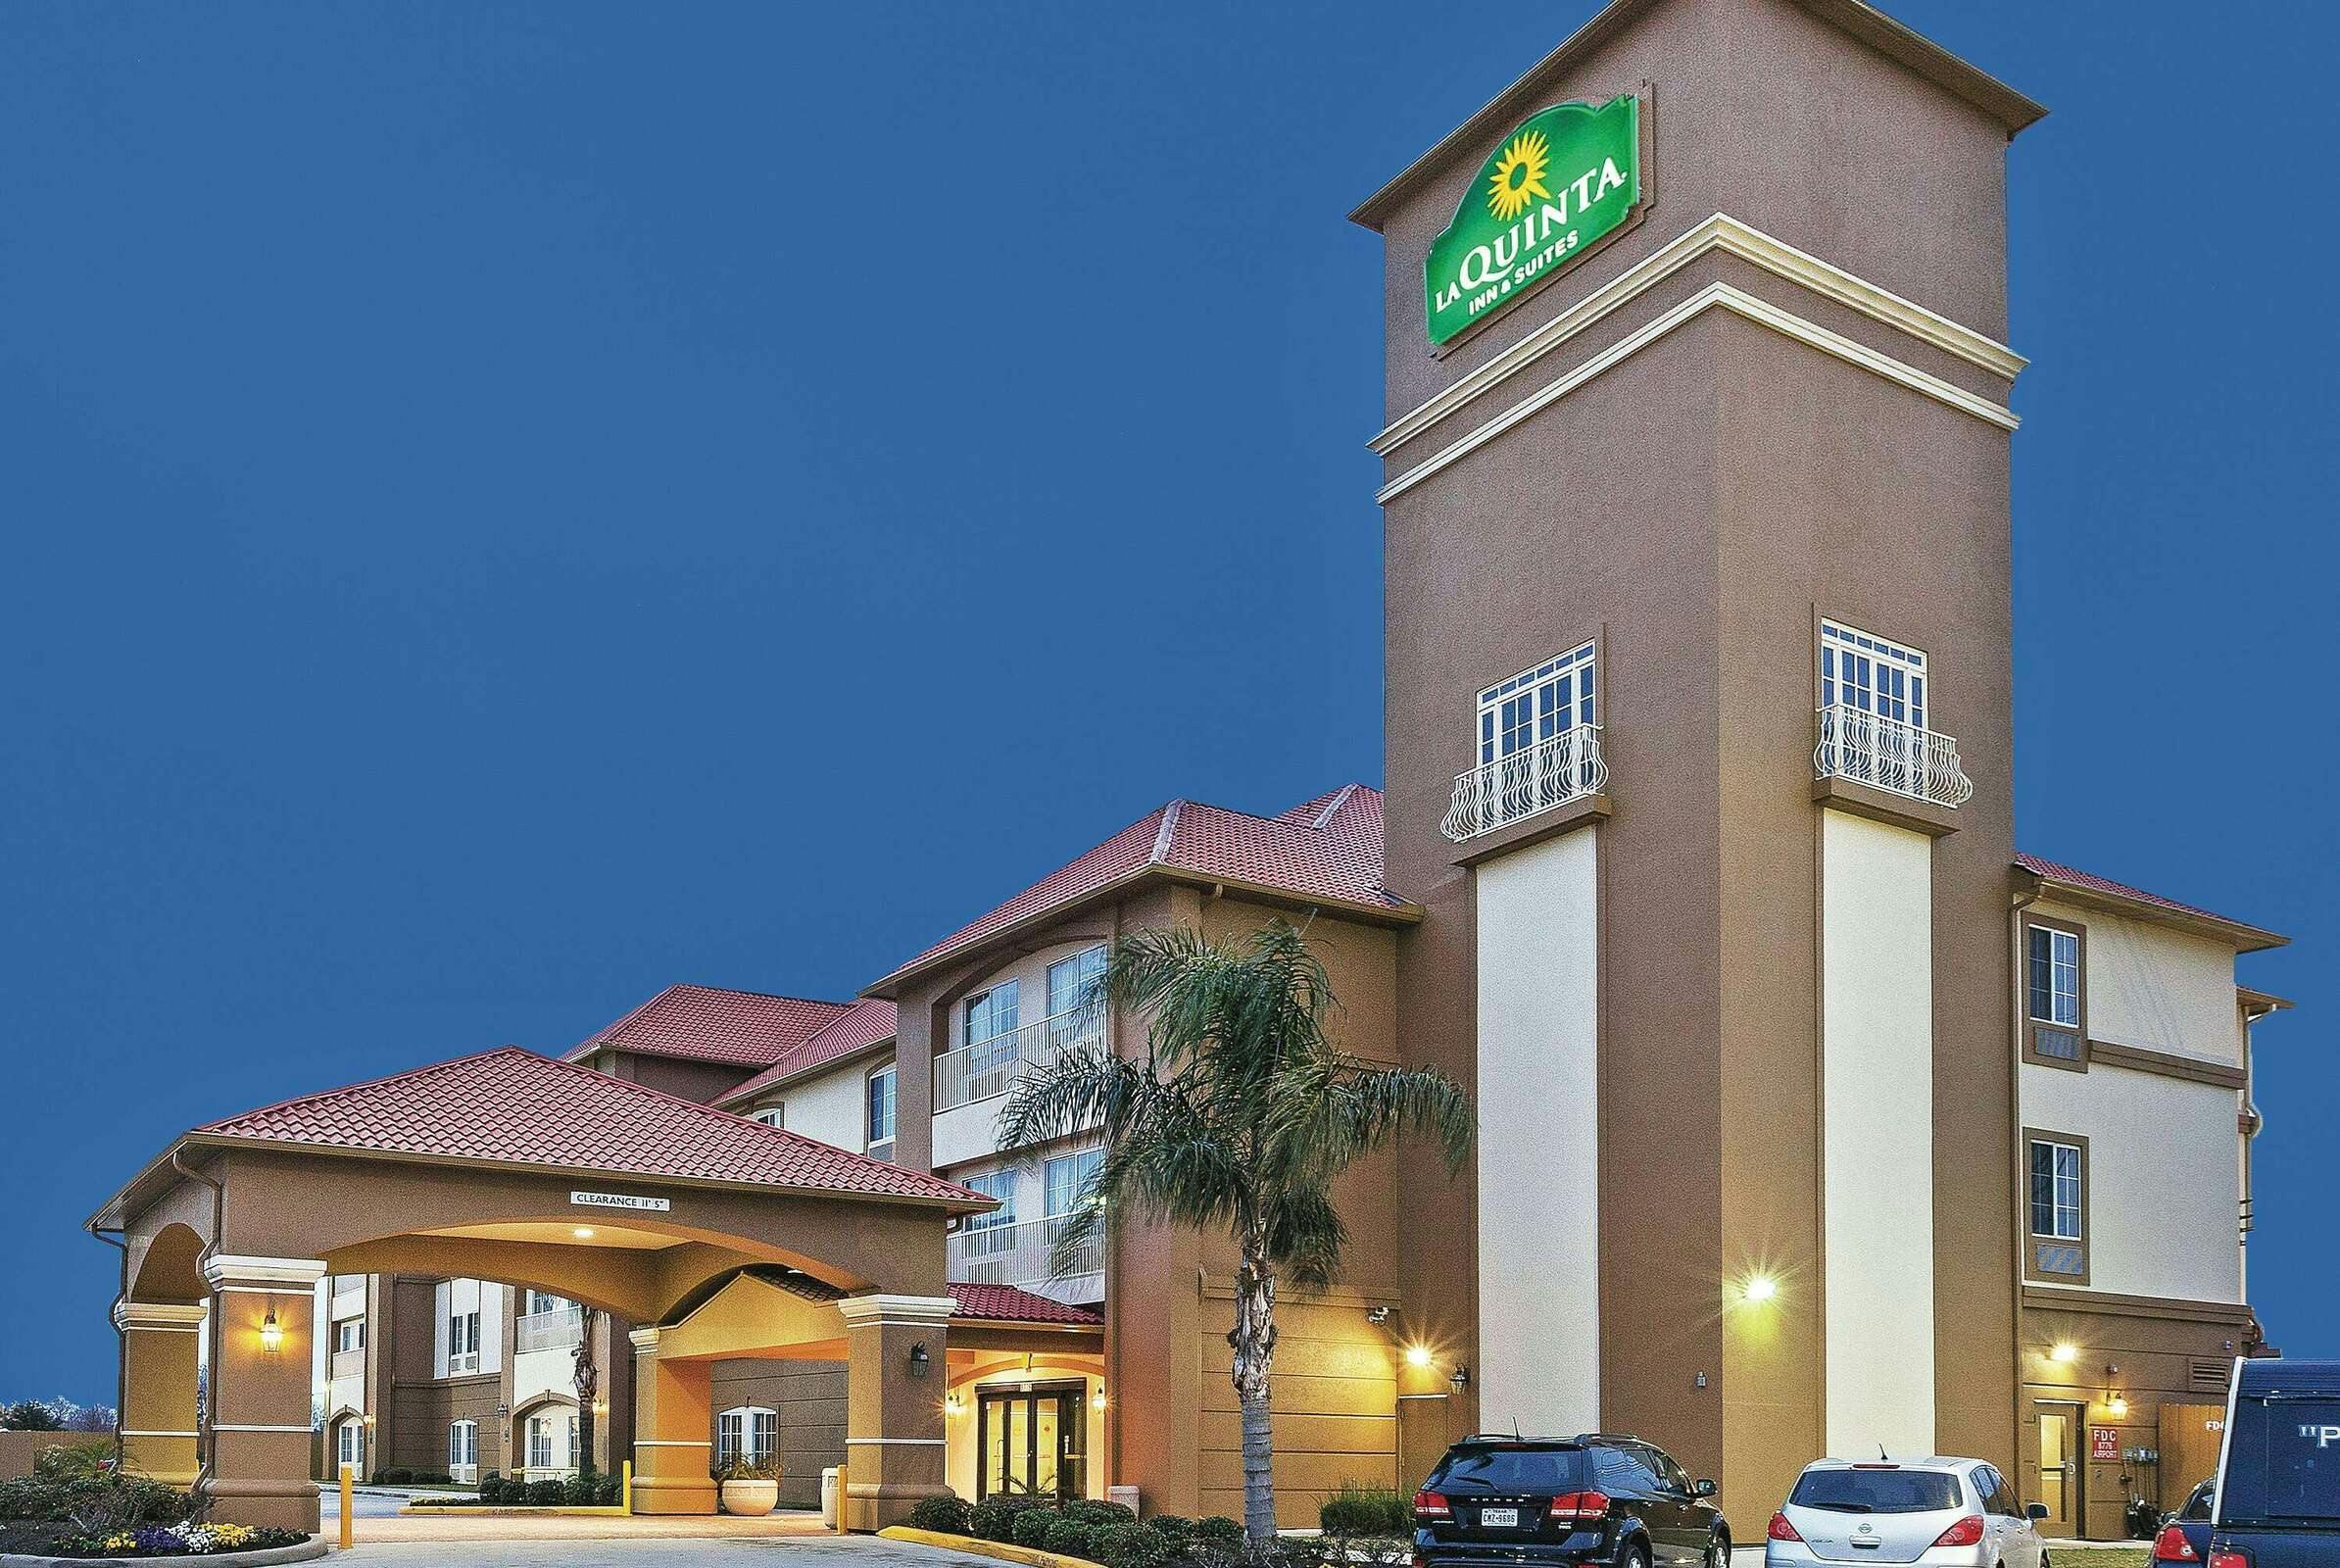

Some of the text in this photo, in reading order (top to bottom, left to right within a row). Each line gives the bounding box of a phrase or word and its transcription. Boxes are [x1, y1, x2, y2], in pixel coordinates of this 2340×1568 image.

[1435, 156, 1627, 314] LA QUINTA
[1469, 229, 1580, 316] INN & SUITES
[576, 1195, 637, 1206] CLEARANCE
[2093, 1429, 2117, 1442] FDC
